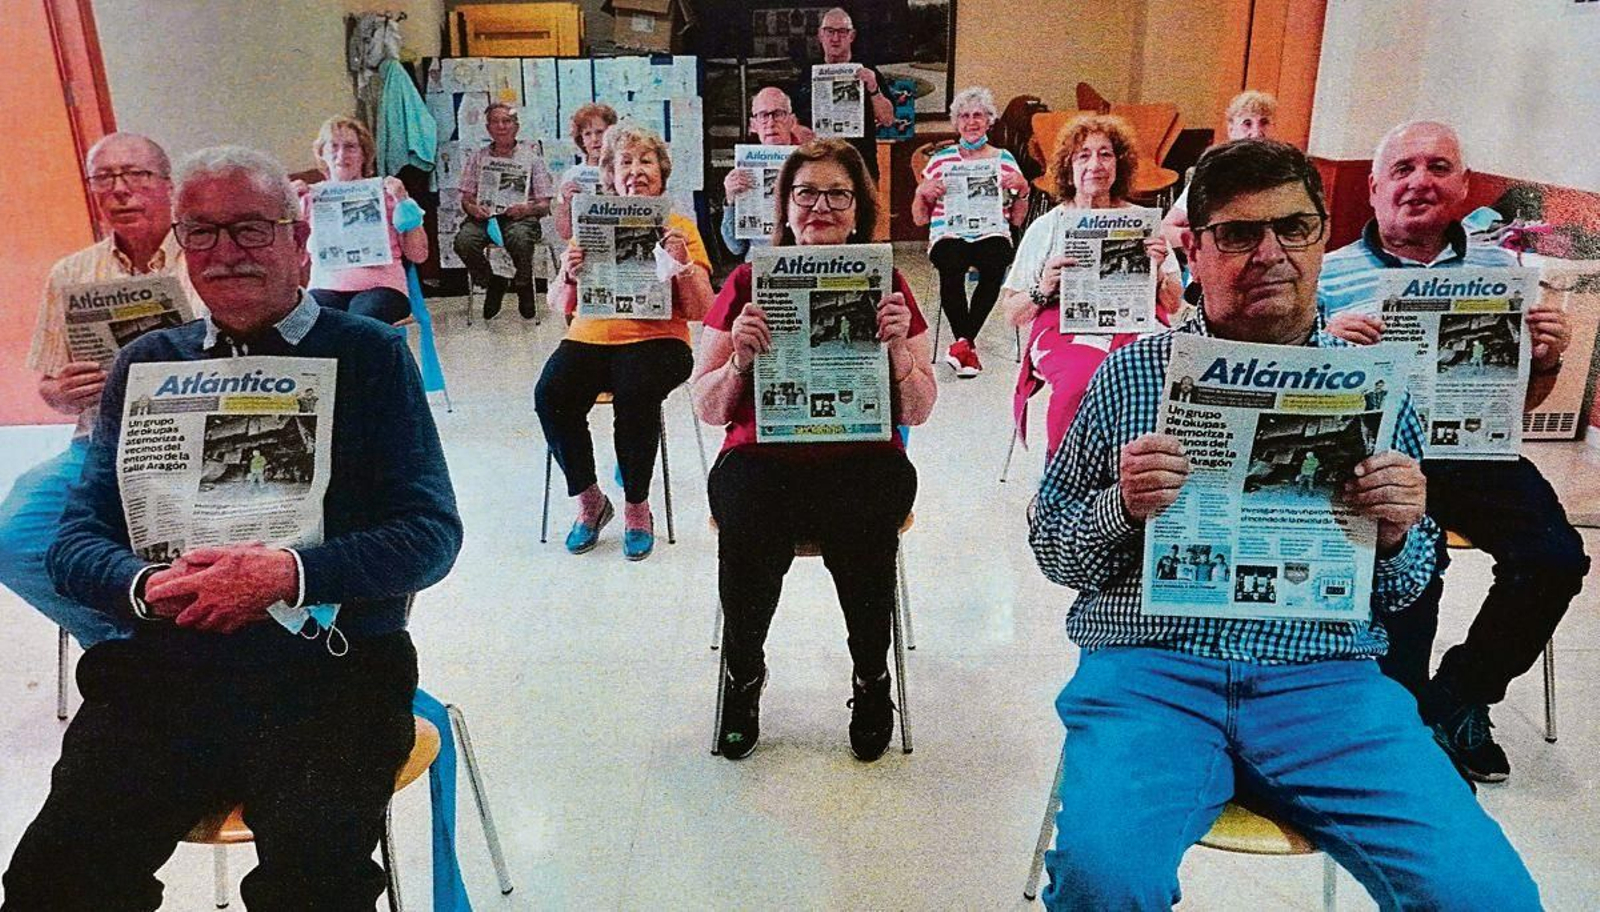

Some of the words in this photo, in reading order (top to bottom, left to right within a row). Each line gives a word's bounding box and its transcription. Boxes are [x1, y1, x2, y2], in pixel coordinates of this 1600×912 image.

[588, 203, 653, 216] Atlántico
[1077, 215, 1143, 229] Atlántico
[772, 256, 866, 274] Atlántico
[1402, 277, 1508, 297] Atlántico
[69, 287, 153, 310] Atlántico
[1199, 357, 1366, 389] Atlántico
[155, 370, 296, 396] Atlántico
[1168, 404, 1185, 415] Un
[1185, 409, 1222, 419] grupo
[129, 420, 143, 428] Un
[144, 418, 174, 427] grupo
[1166, 416, 1181, 425] de
[1182, 419, 1227, 429] okupas
[1209, 440, 1228, 448] del
[1209, 449, 1224, 457] de
[1225, 450, 1236, 458] la
[146, 461, 187, 471] Aragón
[1191, 457, 1233, 467] Aragón
